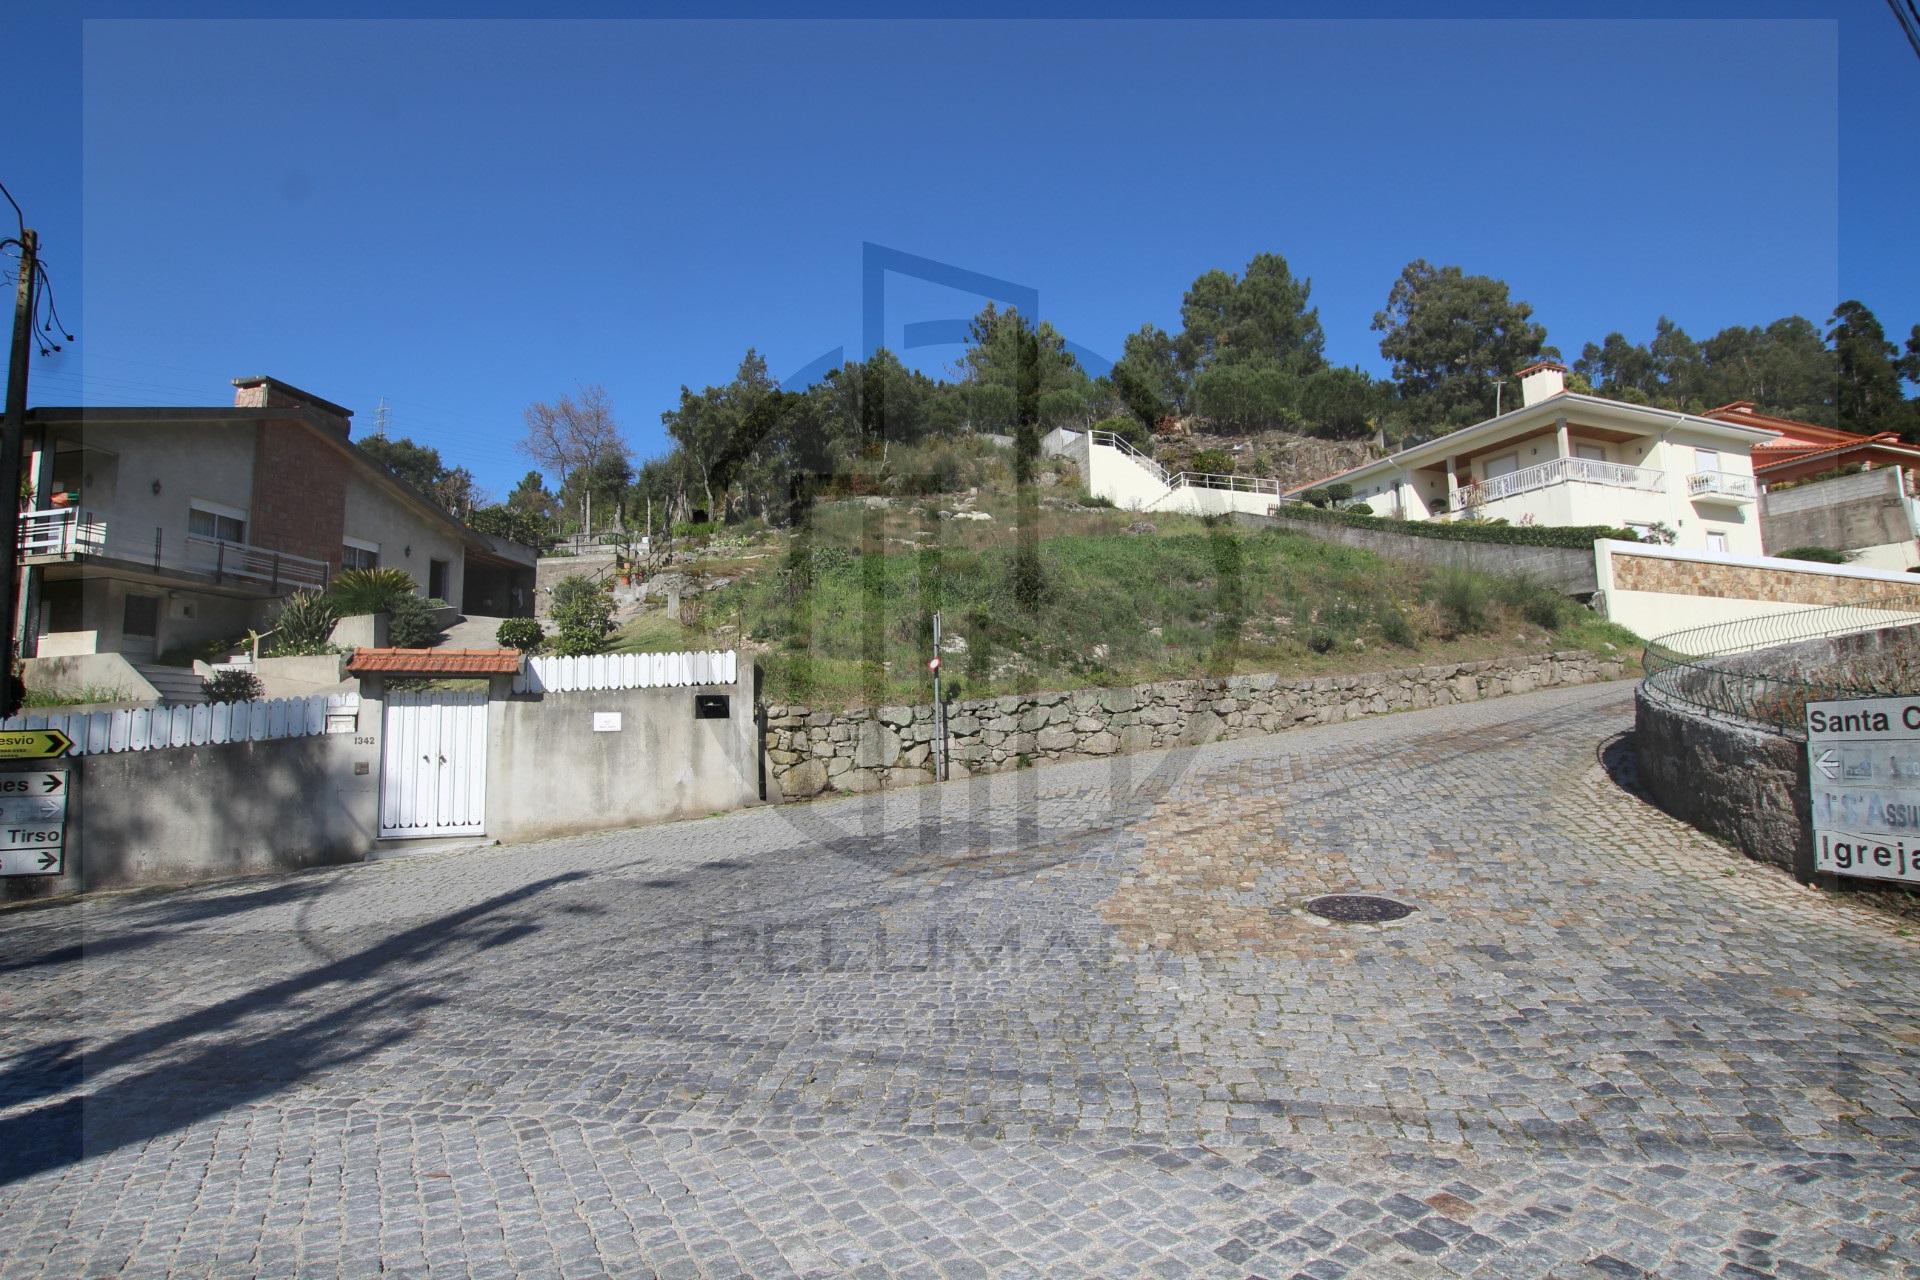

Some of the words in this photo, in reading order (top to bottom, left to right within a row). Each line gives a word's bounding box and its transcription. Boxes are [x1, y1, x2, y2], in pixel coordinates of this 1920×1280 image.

[1810, 709, 1890, 733] Santa
[354, 737, 375, 745] 1342
[0, 780, 29, 793] es
[8, 829, 59, 843] Tirso
